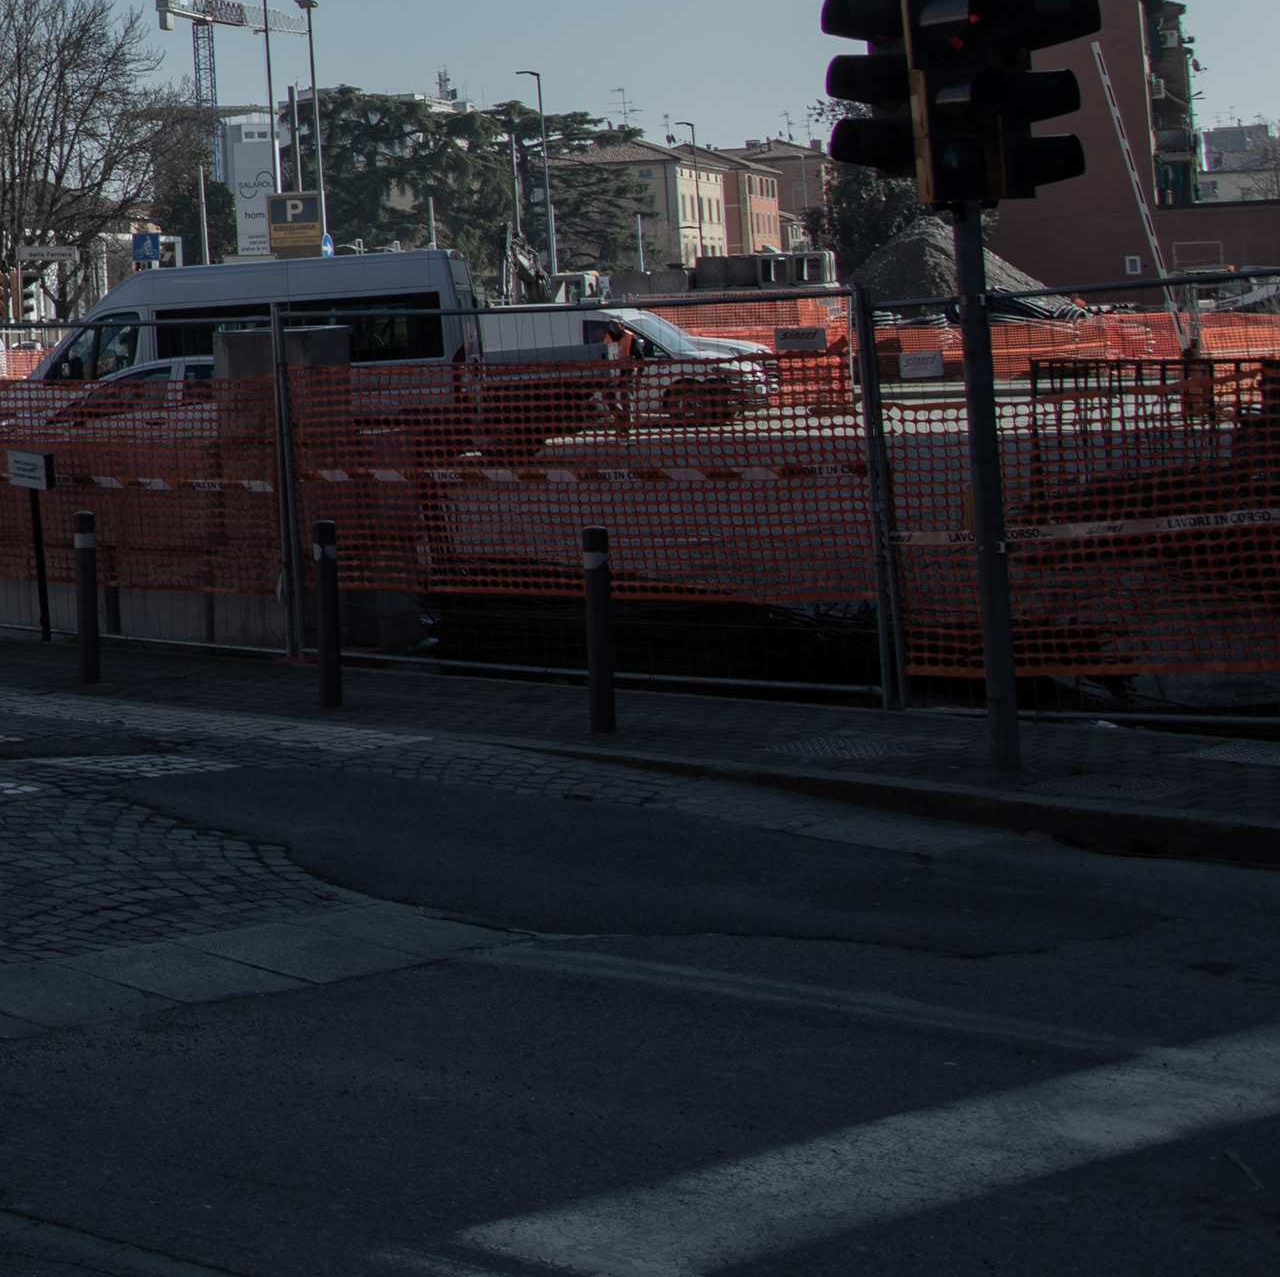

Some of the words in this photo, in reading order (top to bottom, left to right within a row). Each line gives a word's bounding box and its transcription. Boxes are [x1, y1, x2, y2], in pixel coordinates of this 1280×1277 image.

[244, 211, 265, 220] hom
[286, 199, 304, 222] P
[274, 224, 317, 232] ESSELUNGA
[405, 471, 435, 480] LAVORI
[437, 471, 447, 480] IN
[579, 471, 611, 481] LAVORI
[614, 471, 625, 480] IN
[782, 466, 823, 478] LAVORI
[826, 466, 837, 475] IN
[177, 481, 205, 490] LAVORI
[206, 481, 216, 490] IN
[1167, 515, 1210, 529] LAVORI
[1214, 514, 1228, 526] IN
[948, 532, 976, 543] LAVO
